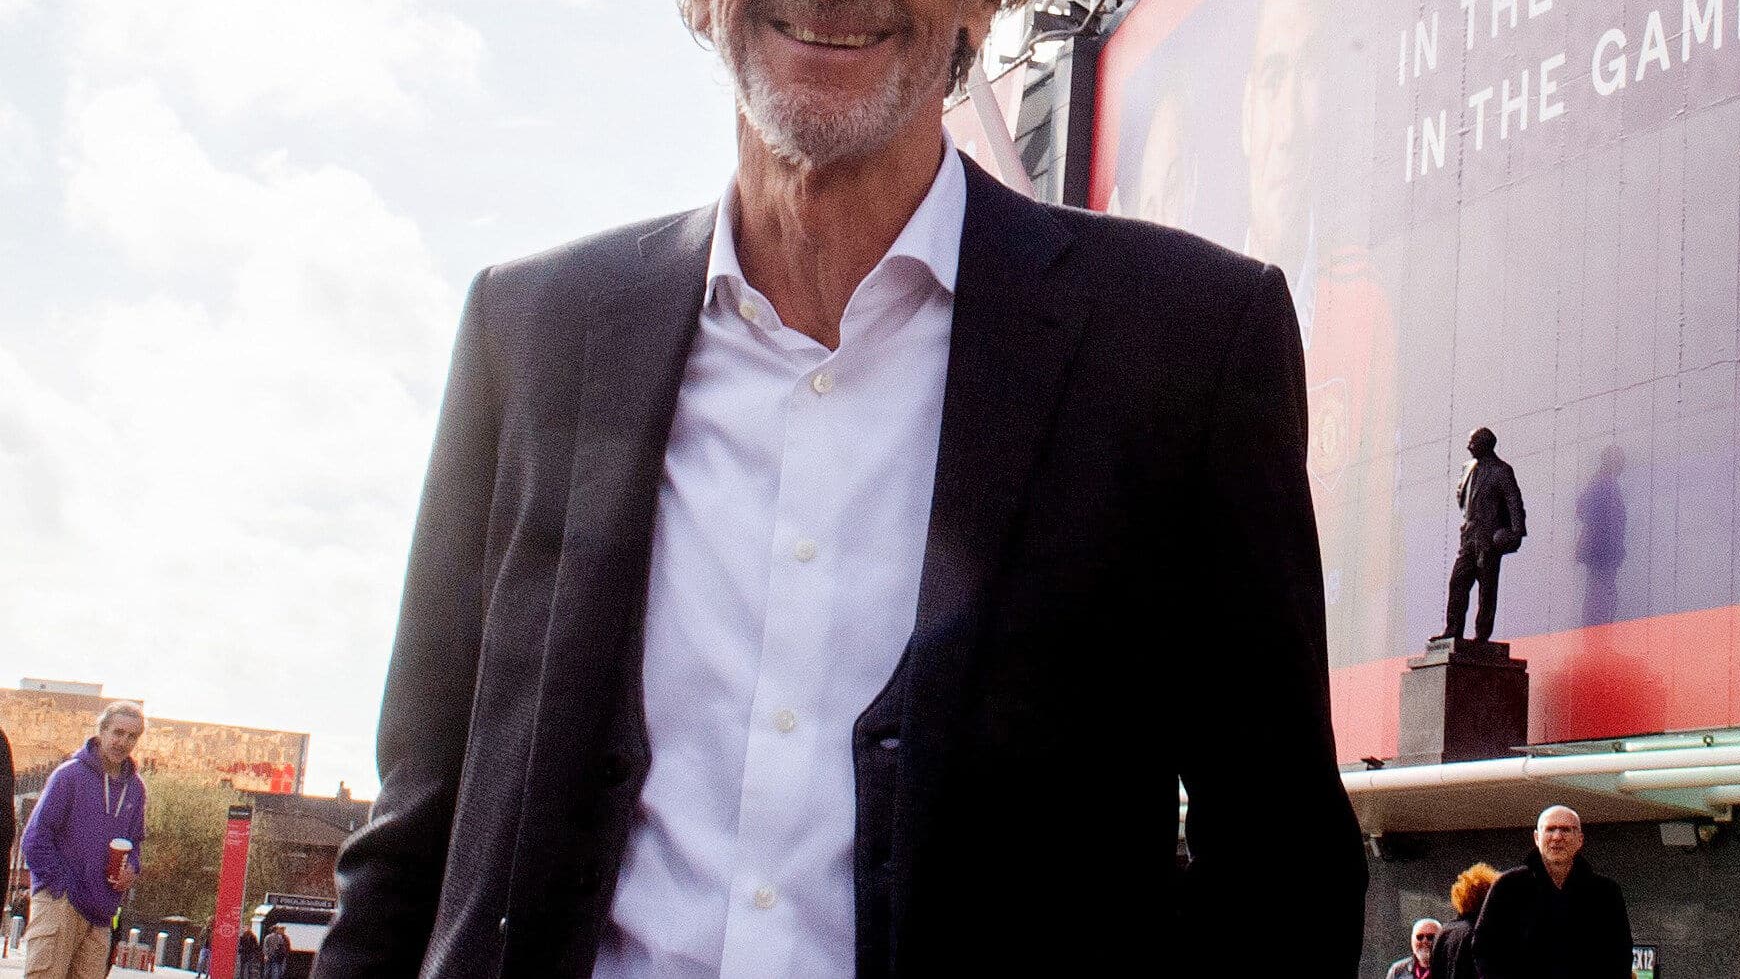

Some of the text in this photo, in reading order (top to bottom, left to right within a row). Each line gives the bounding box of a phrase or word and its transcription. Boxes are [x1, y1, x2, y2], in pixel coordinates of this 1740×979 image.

[1399, 11, 1440, 86] IN
[1405, 109, 1447, 182] IN
[1468, 52, 1567, 150] THE
